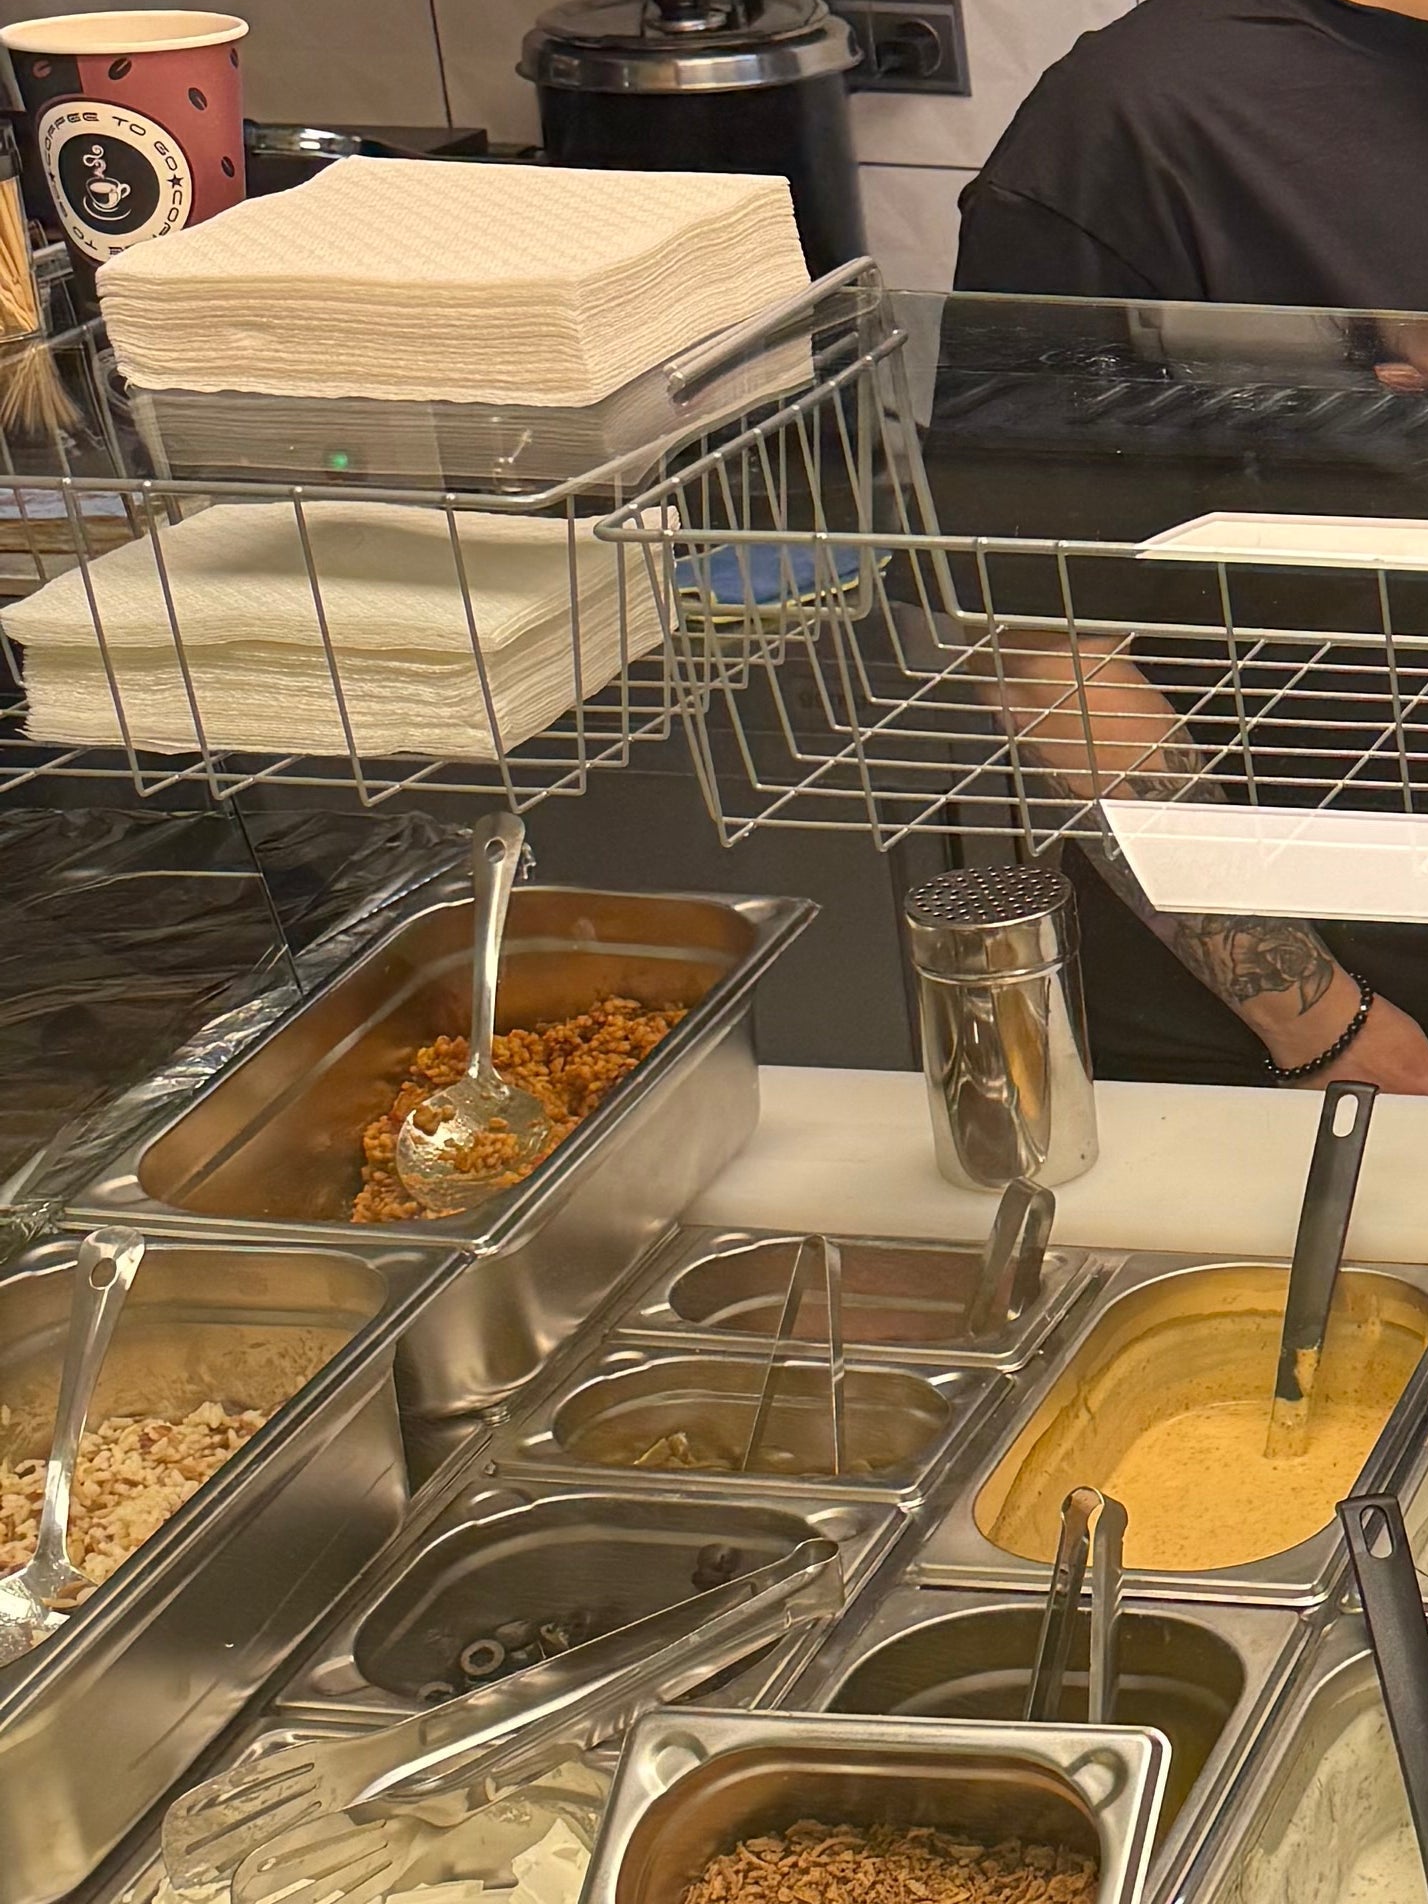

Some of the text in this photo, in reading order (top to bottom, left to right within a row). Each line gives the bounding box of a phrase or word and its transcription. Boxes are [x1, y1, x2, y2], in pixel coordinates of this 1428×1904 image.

[44, 112, 178, 172] COFFEE TO GO
